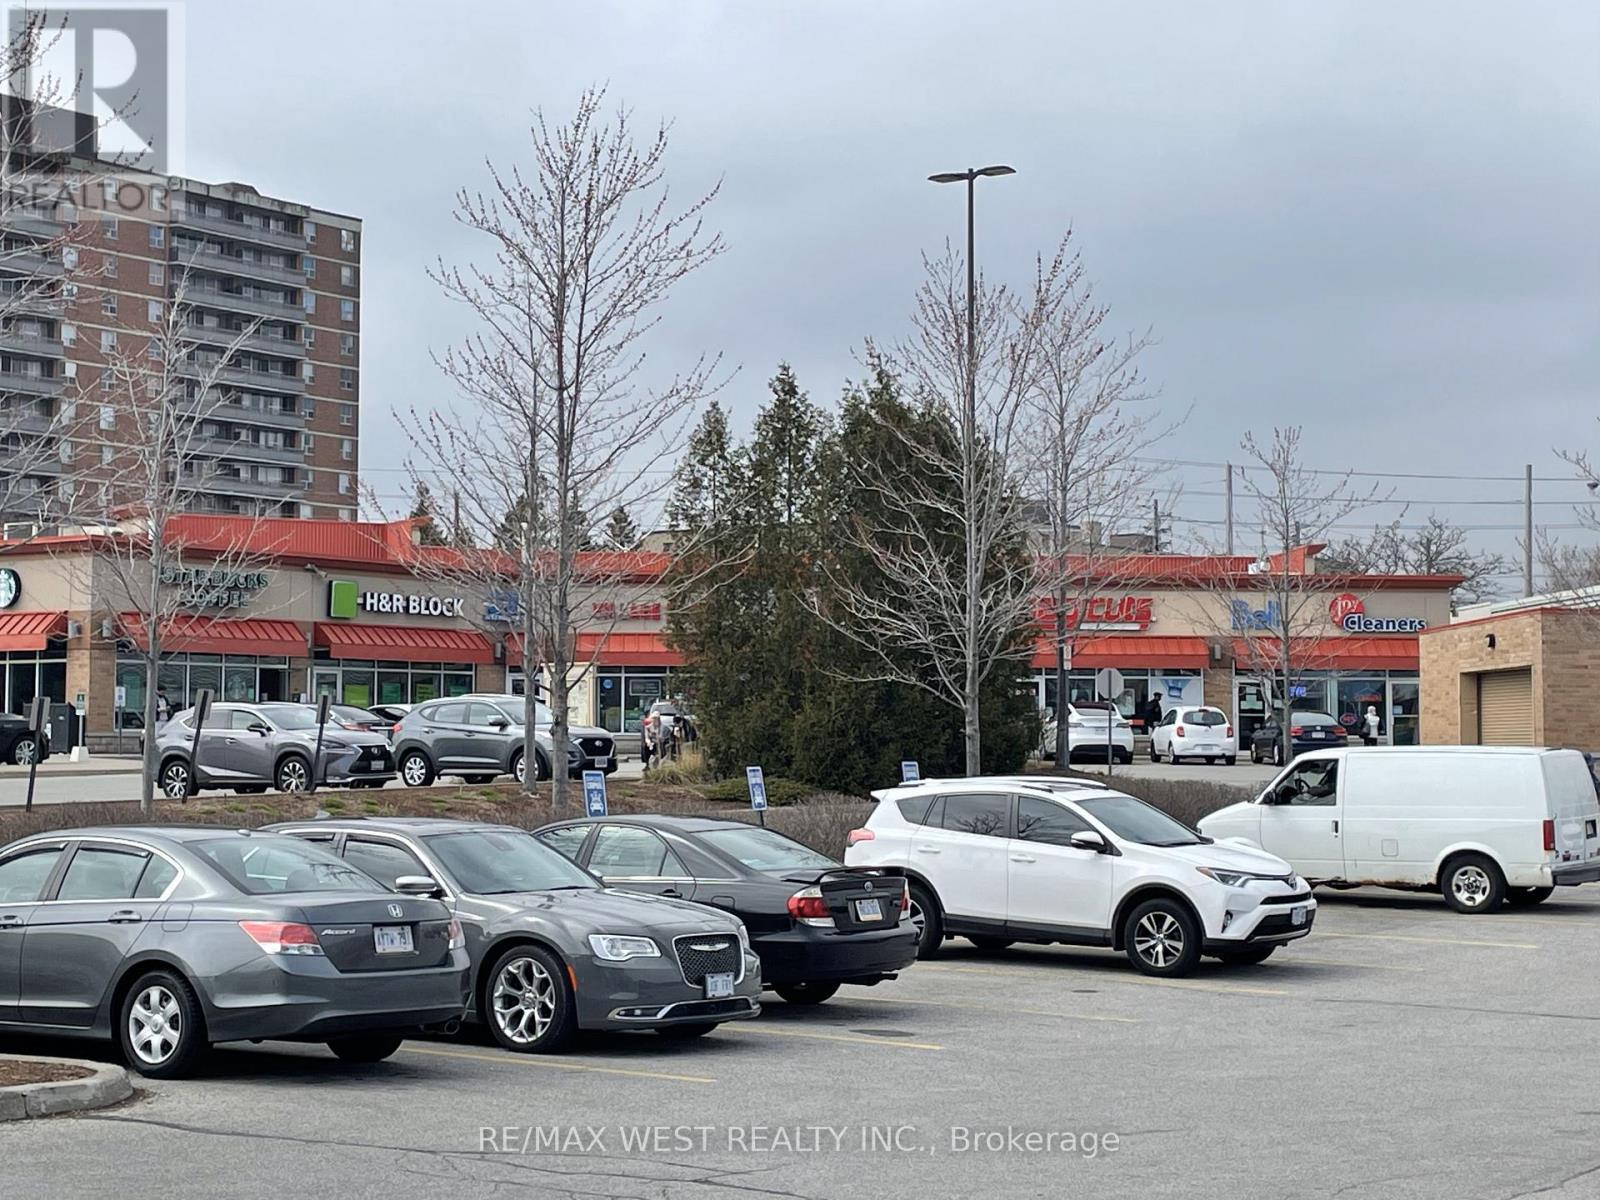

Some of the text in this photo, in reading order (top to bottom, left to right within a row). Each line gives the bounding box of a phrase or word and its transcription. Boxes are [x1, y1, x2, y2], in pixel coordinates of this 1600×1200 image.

[365, 591, 403, 613] H&R
[408, 596, 464, 617] BLOCK
[1343, 613, 1426, 632] Cleaners
